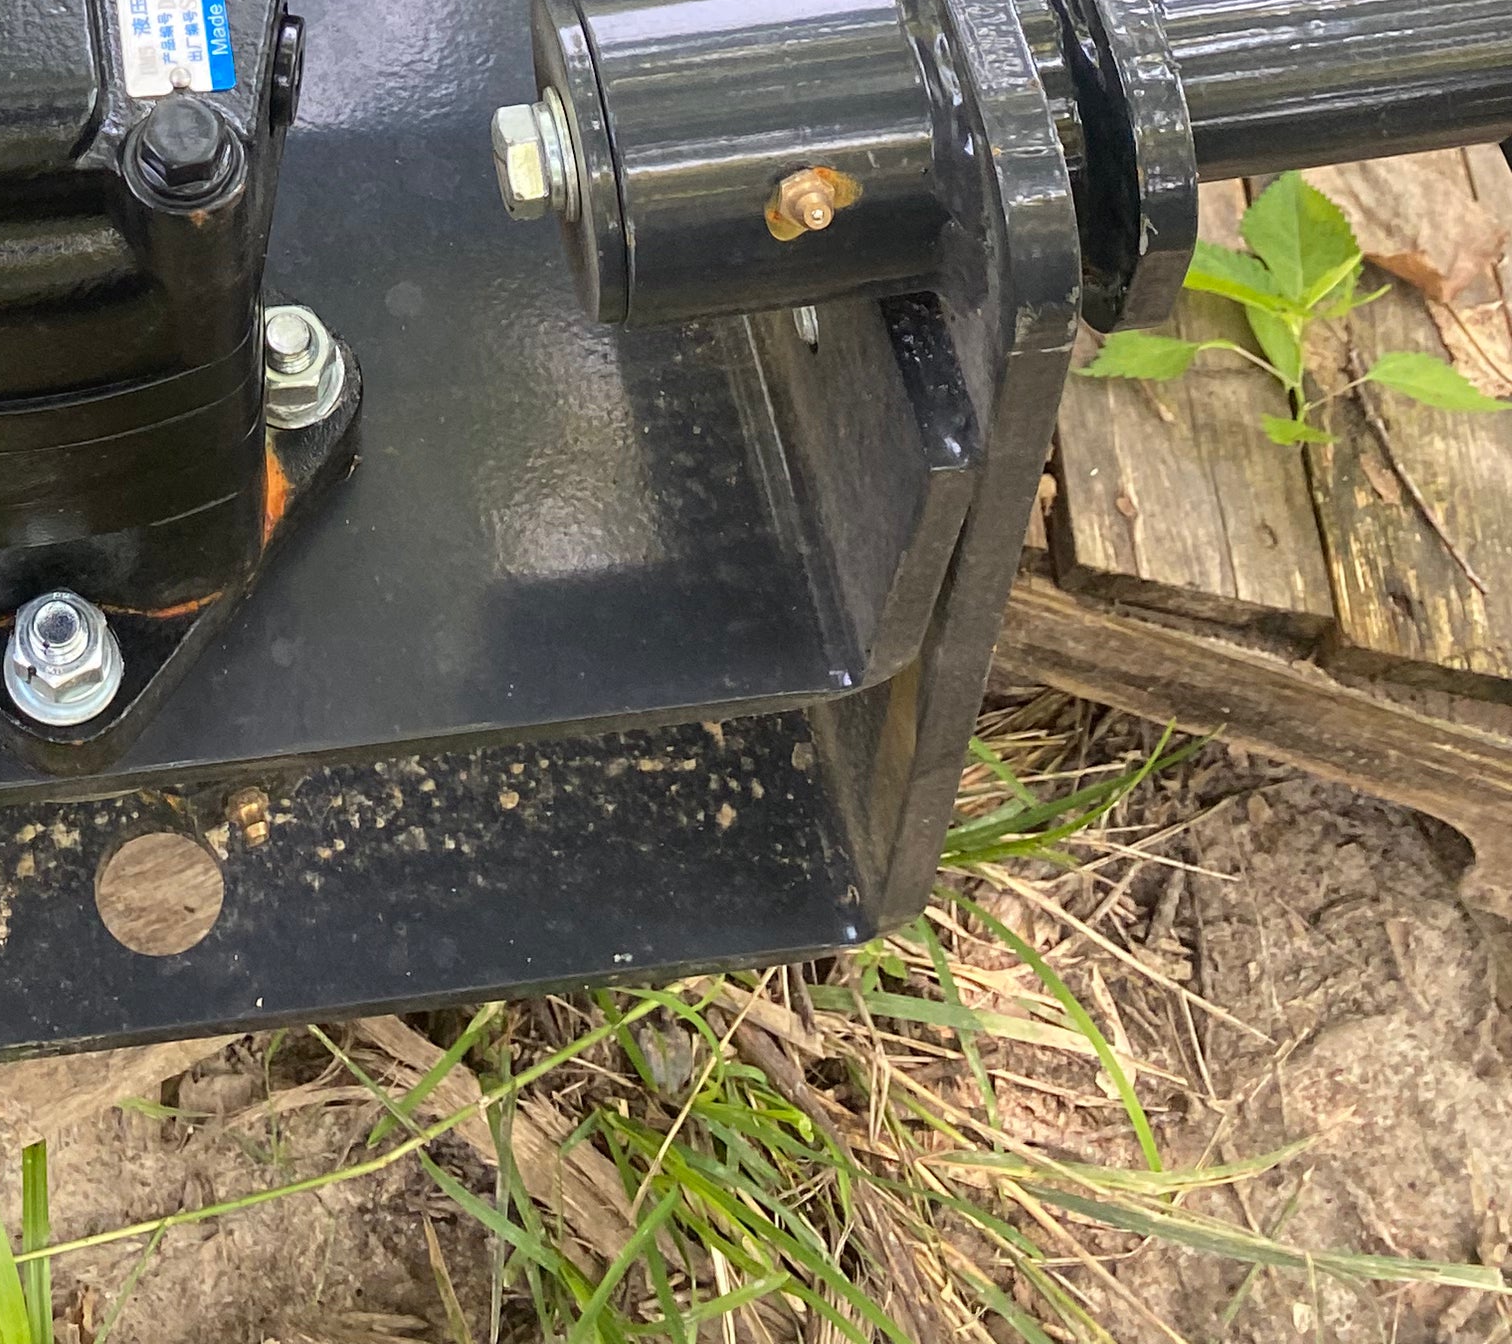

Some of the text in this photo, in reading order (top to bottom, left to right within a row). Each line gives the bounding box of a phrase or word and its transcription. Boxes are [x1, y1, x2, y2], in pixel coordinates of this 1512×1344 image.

[157, 12, 178, 65] 产品编号
[182, 10, 203, 62] 出厂编号
[208, 3, 229, 56] Made
